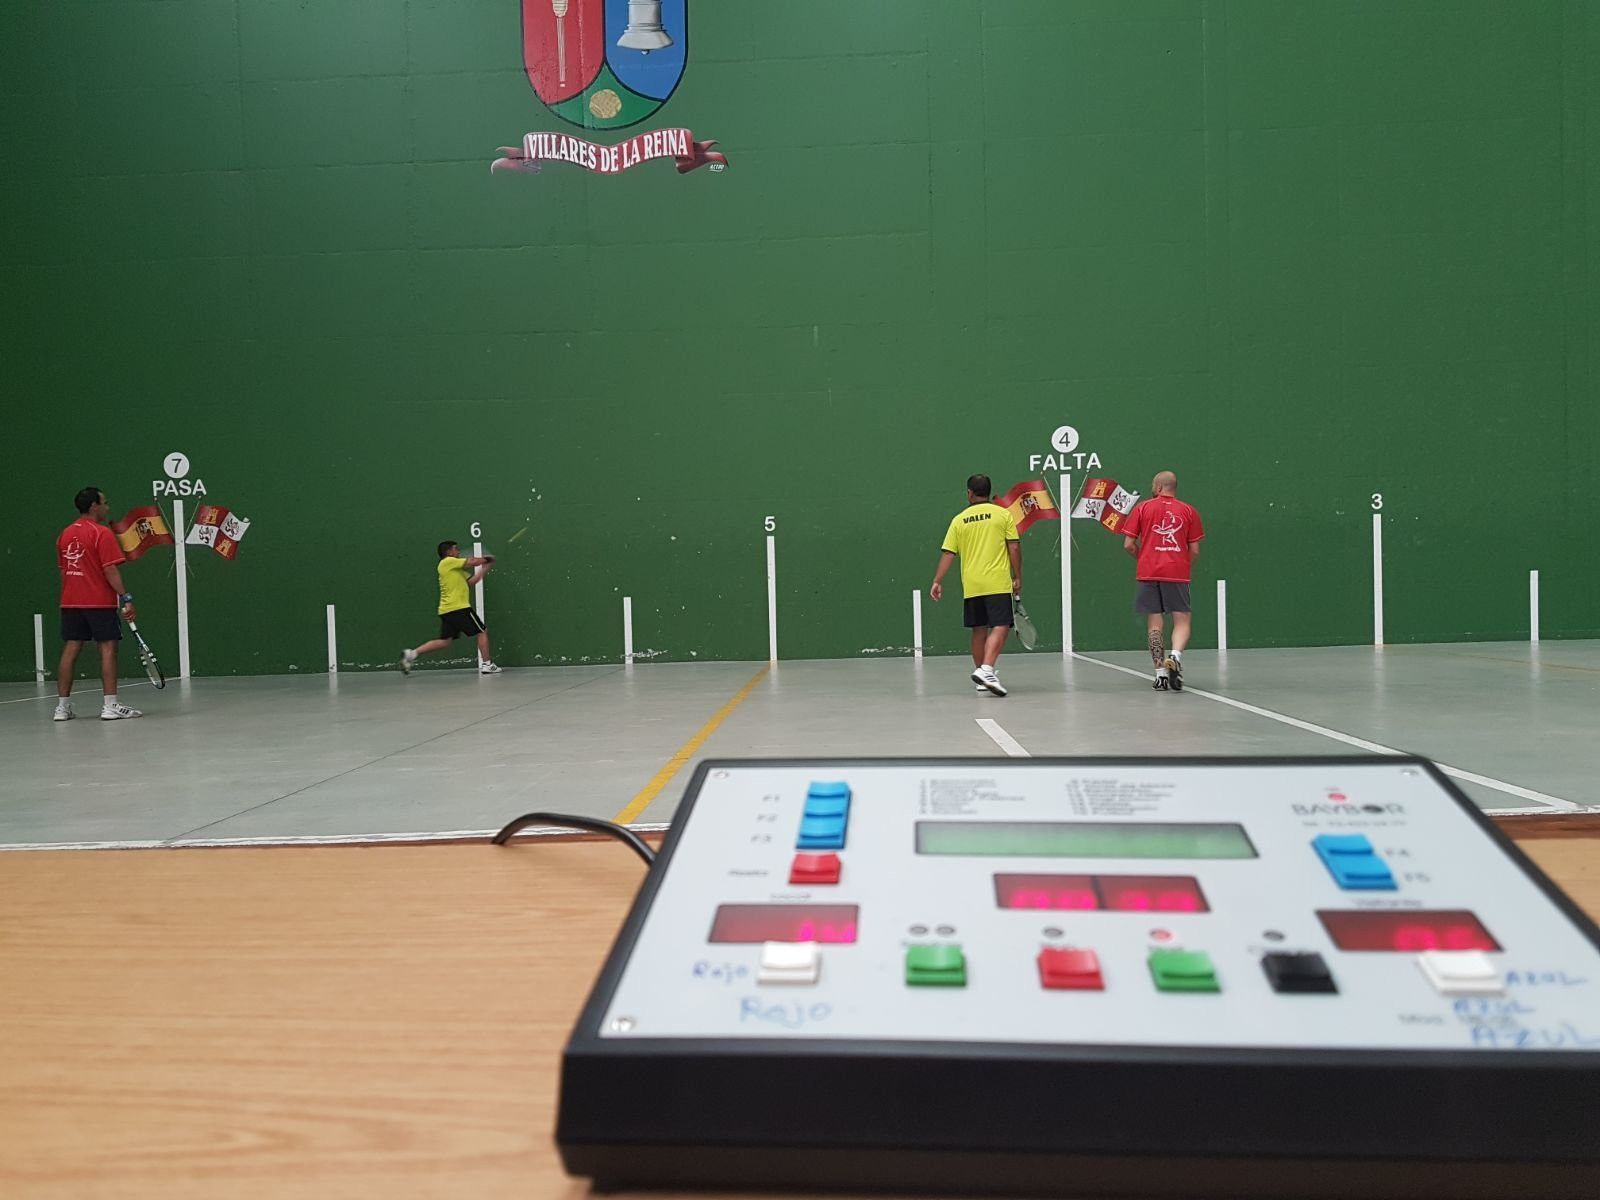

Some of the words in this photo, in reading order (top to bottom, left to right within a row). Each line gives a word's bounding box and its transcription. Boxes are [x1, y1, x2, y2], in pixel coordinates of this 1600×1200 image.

[527, 133, 597, 170] VILLARES
[600, 146, 619, 173] DE
[622, 138, 641, 169] LA
[644, 129, 689, 160] REINA
[1059, 432, 1070, 447] 4
[171, 458, 182, 473] 7
[1029, 452, 1102, 471] FALTA
[152, 479, 207, 496] PASA
[1371, 493, 1383, 510] 3
[764, 516, 776, 531] 5
[963, 513, 992, 524] VALEN
[470, 522, 482, 538] 6
